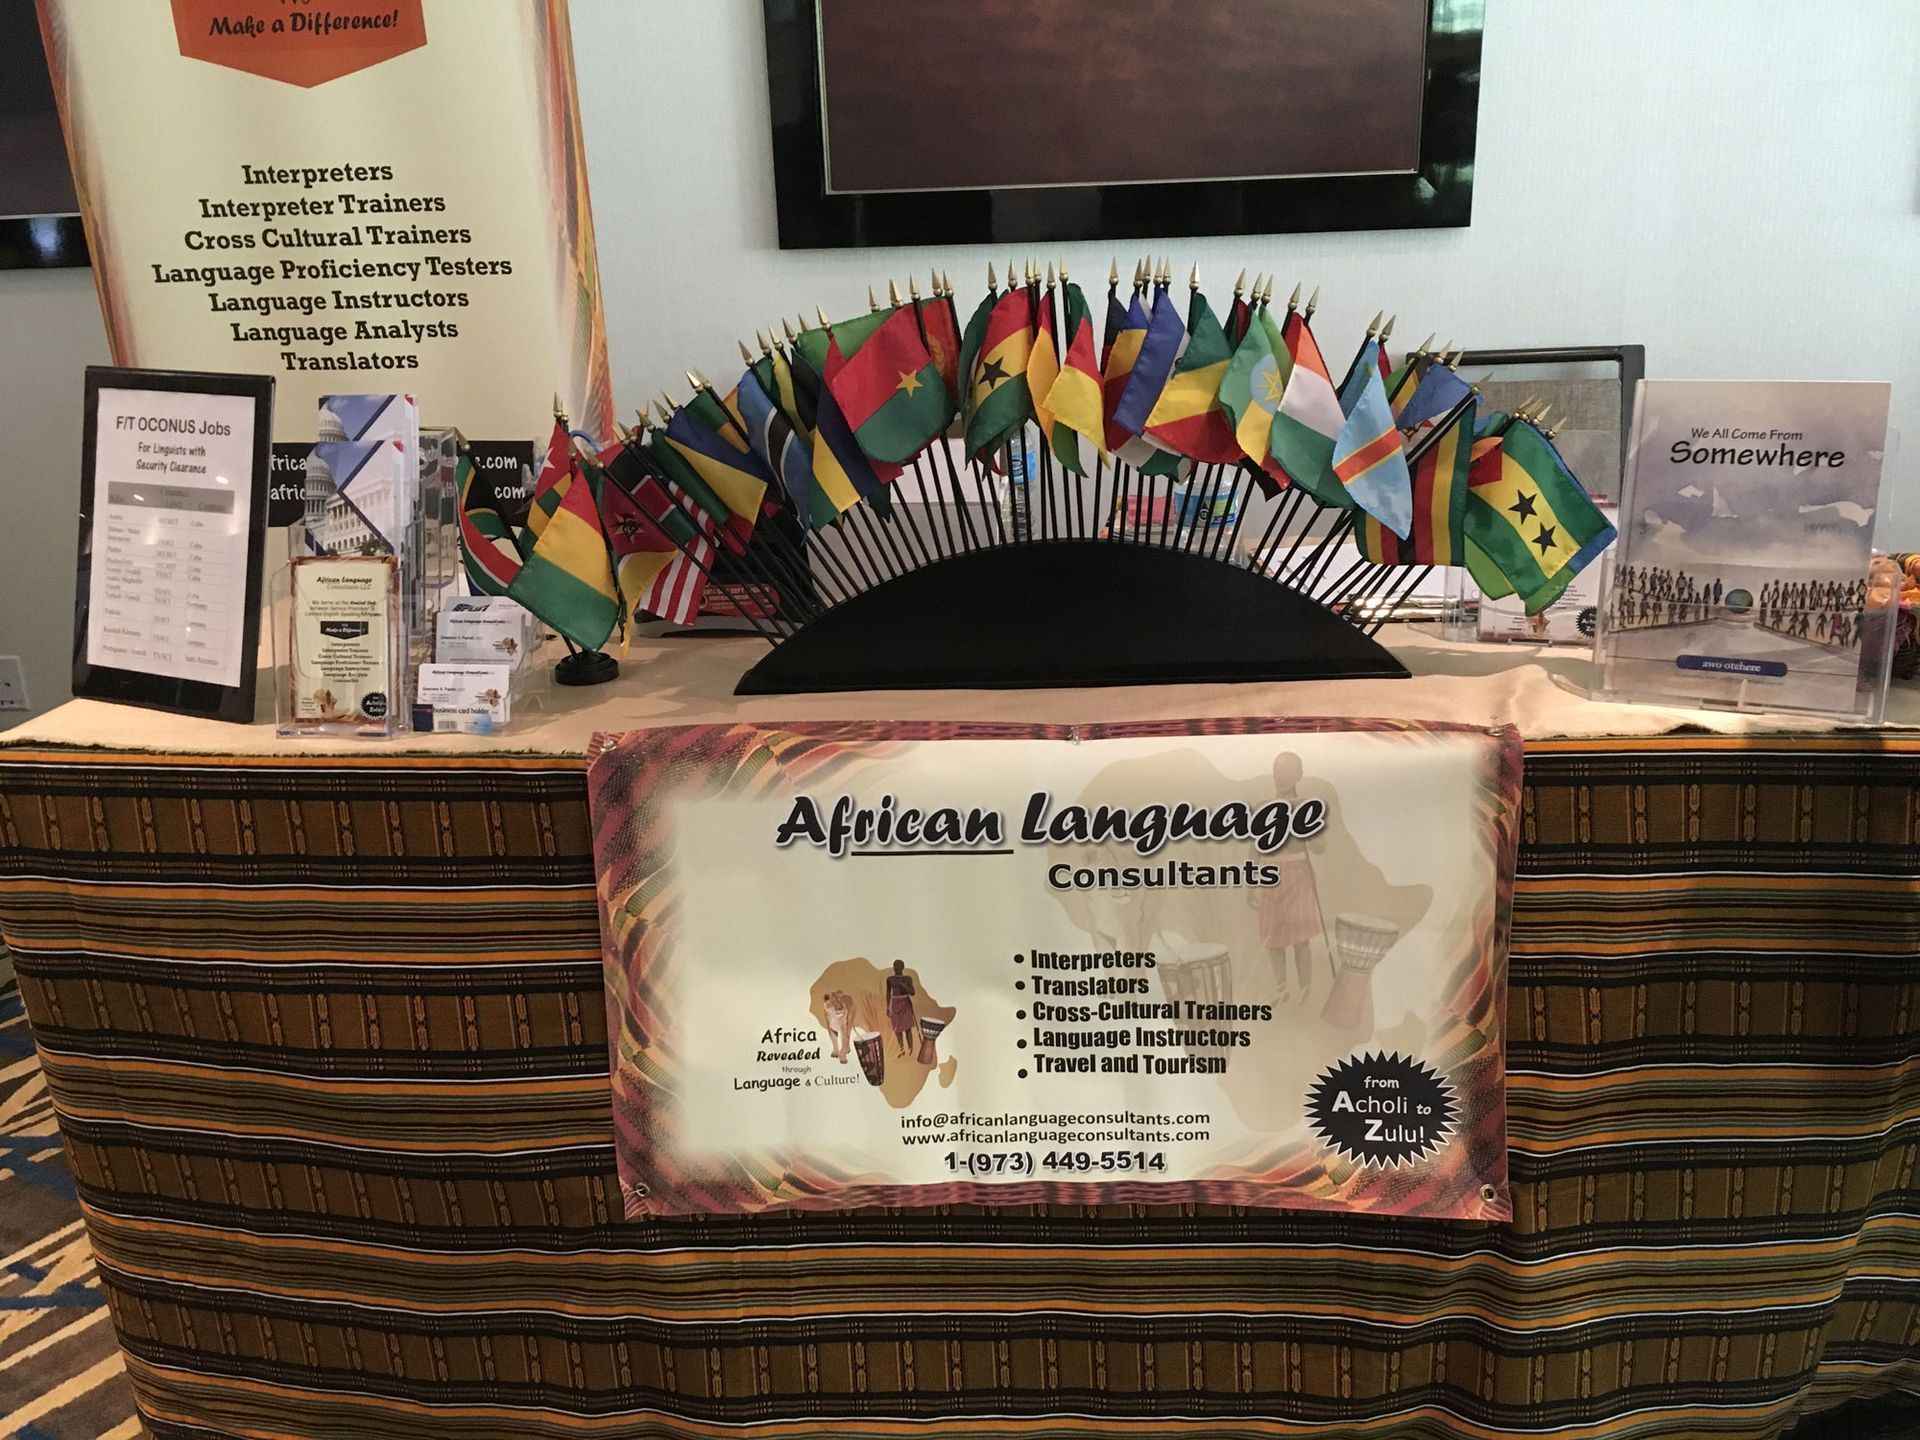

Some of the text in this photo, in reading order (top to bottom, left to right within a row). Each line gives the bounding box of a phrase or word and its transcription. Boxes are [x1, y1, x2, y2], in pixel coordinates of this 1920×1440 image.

[210, 9, 399, 38] Make a Difference!
[241, 163, 393, 189] Interpreters
[198, 192, 446, 222] Interpreter Trainers
[184, 224, 472, 250] Cross Cultural Trainers
[152, 256, 512, 287] Language Proficiency Testers
[208, 290, 469, 316] Language Instructors
[230, 320, 459, 346] Language Analysts
[281, 352, 419, 371] Translators
[116, 416, 231, 436] F/T OCONUS Jobs
[1691, 428, 1803, 441] We All Come From
[138, 442, 206, 457] For Linguists with
[1670, 440, 1845, 468] Somewhere
[136, 459, 207, 475] Security Clearance
[1702, 660, 1722, 668] awo
[775, 793, 1327, 856] African Language
[1048, 861, 1281, 890] Consultants
[1031, 950, 1156, 972] Interpreters
[1032, 976, 1150, 996] Translators
[1033, 1001, 1272, 1022] Cross-Cultural Trainers
[761, 1028, 817, 1044] Africa
[1034, 1026, 1251, 1049] Language Instructors
[756, 1047, 821, 1062] Revealed
[1034, 1054, 1227, 1074] Travel and Tourism
[782, 1065, 812, 1074] through
[734, 1073, 860, 1092] Language & Culture!
[1363, 1075, 1400, 1089] from
[1332, 1090, 1432, 1115] Acholi to
[901, 1111, 1211, 1129] info@africanlanguageconsultants.com
[902, 1128, 1210, 1146] www.africanlanguageconsultants.com
[1364, 1119, 1425, 1144] Zulu!
[943, 1150, 1166, 1175] 1-(973) 449-5514
